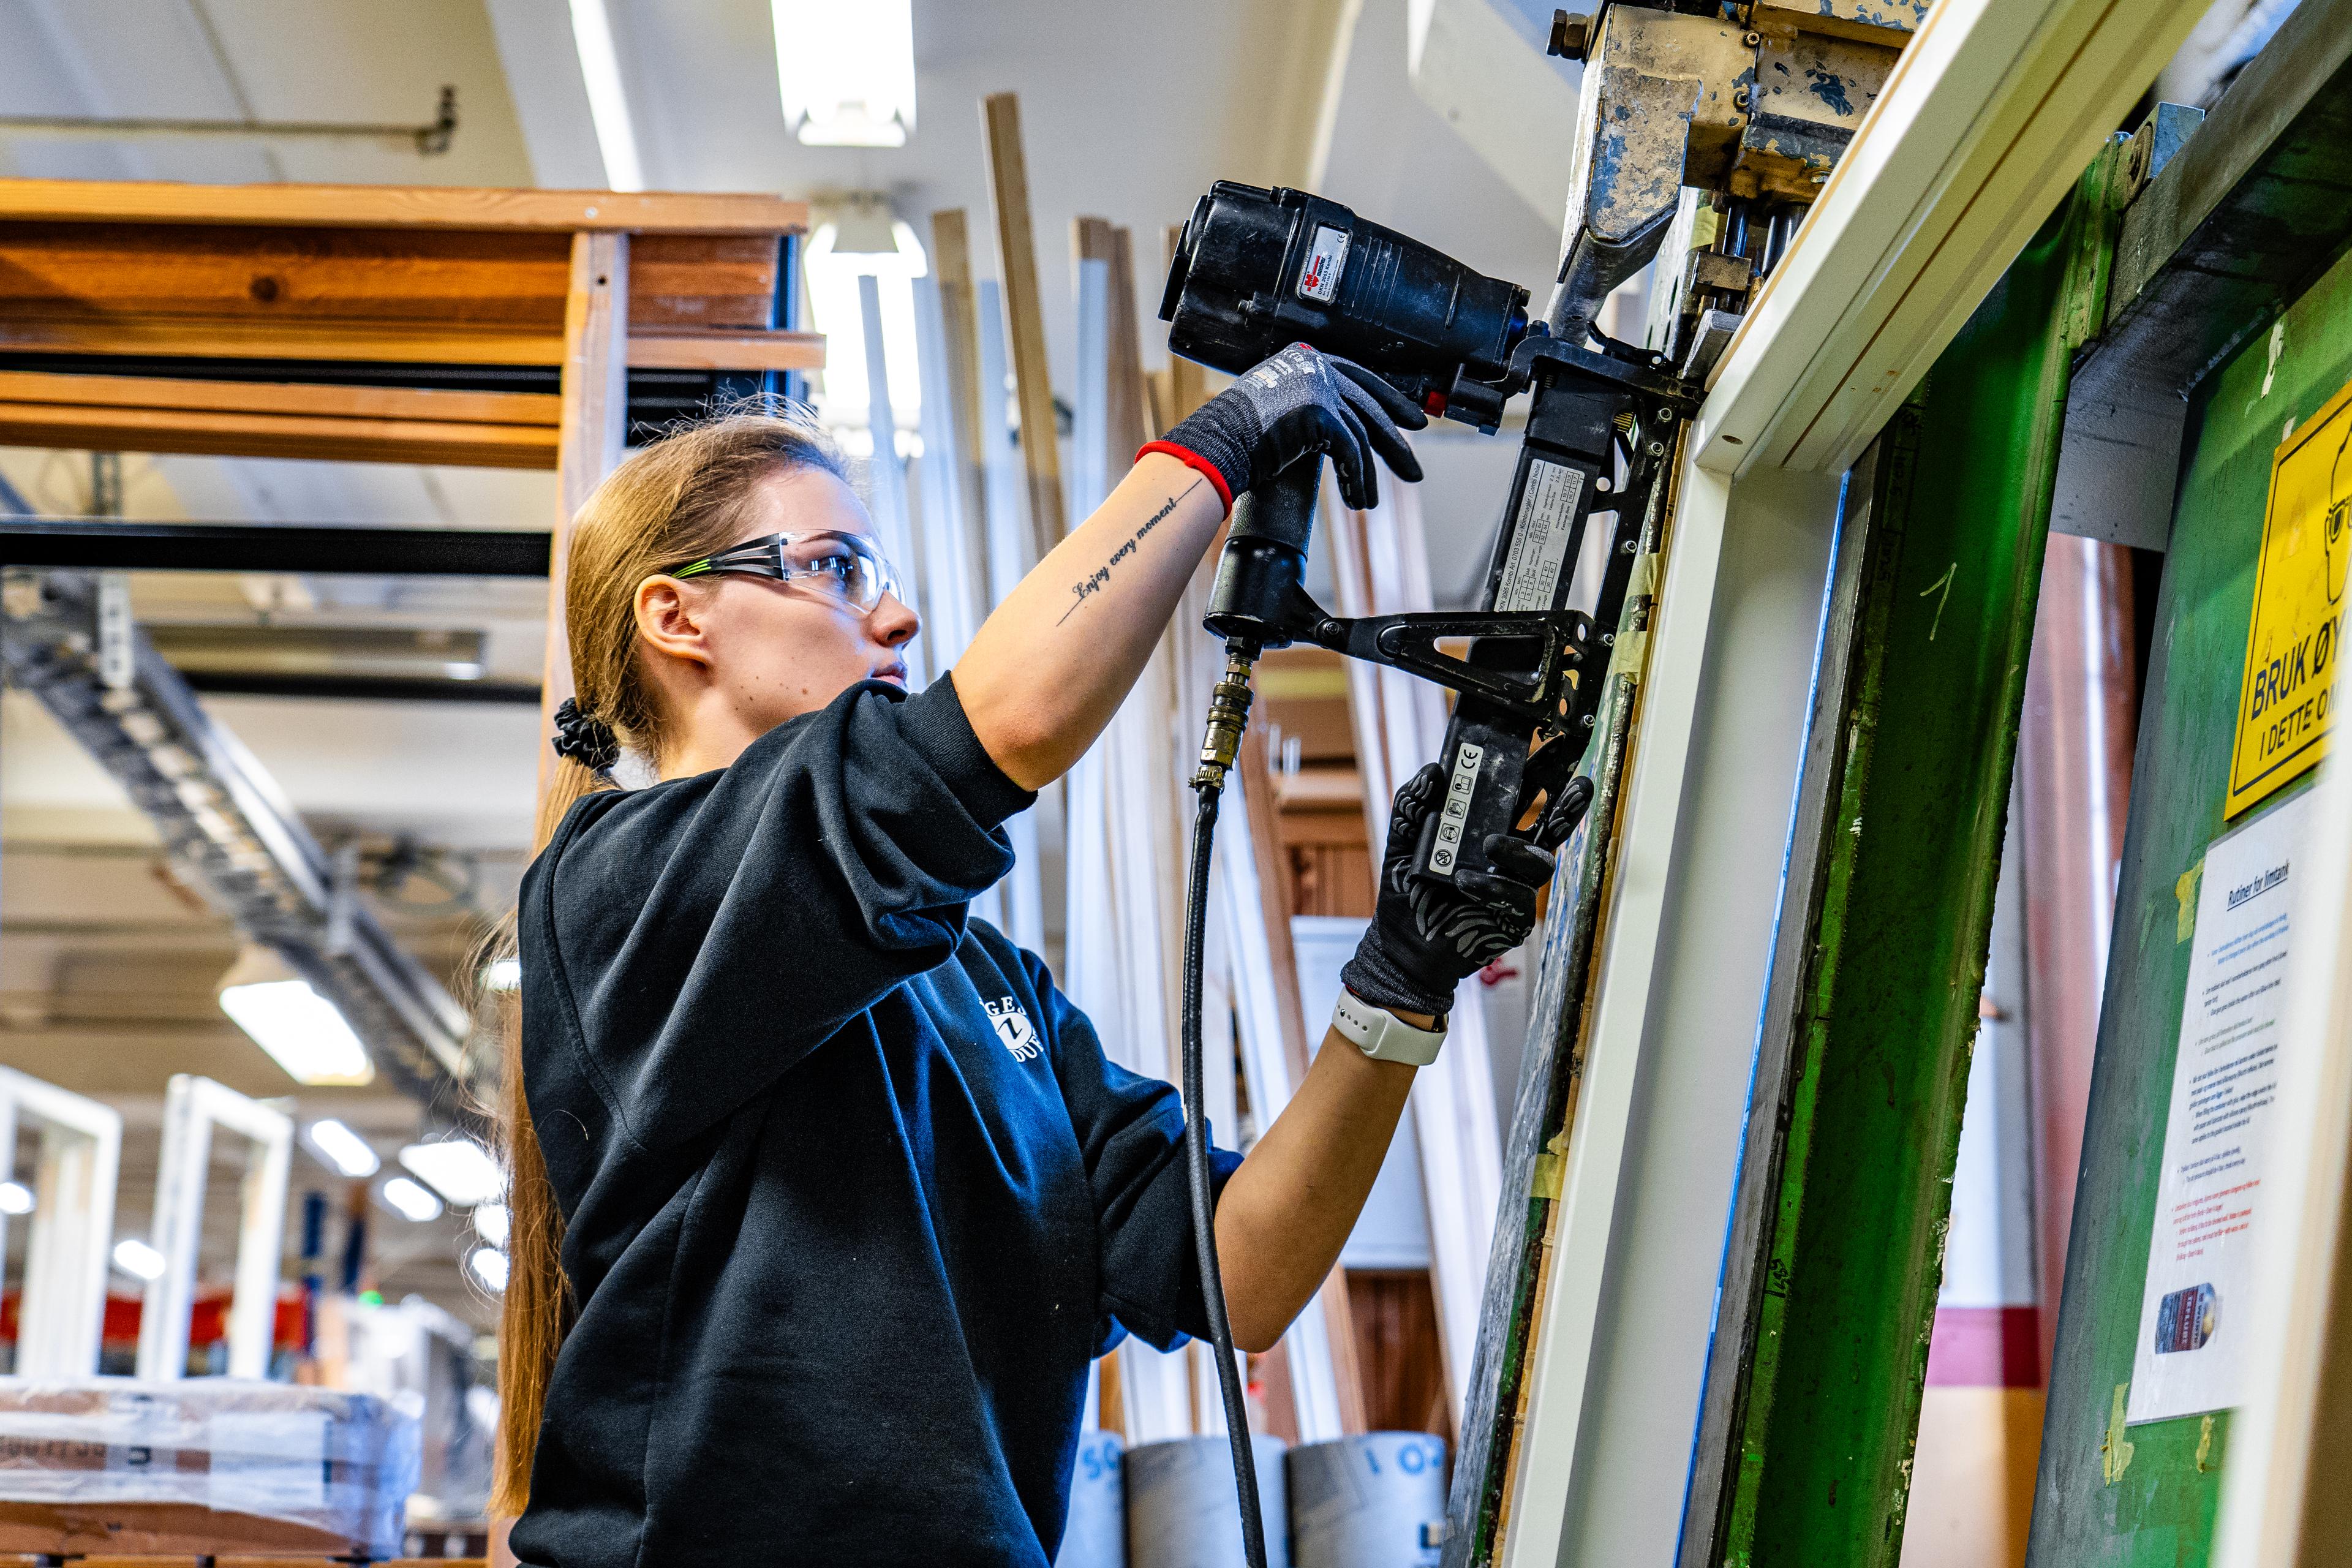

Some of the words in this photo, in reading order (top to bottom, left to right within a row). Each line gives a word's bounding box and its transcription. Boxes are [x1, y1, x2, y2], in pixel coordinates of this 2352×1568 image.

[1317, 257, 1325, 277] master
[1520, 499, 1532, 529] Kombinagler
[1072, 566, 1109, 598] Enjoy
[1109, 538, 1136, 565] every
[1136, 497, 1177, 540] moment
[2252, 634, 2311, 722] BRUK
[2259, 731, 2266, 761] I
[2267, 697, 2314, 756] DETTE
[1461, 748, 1478, 769] CE
